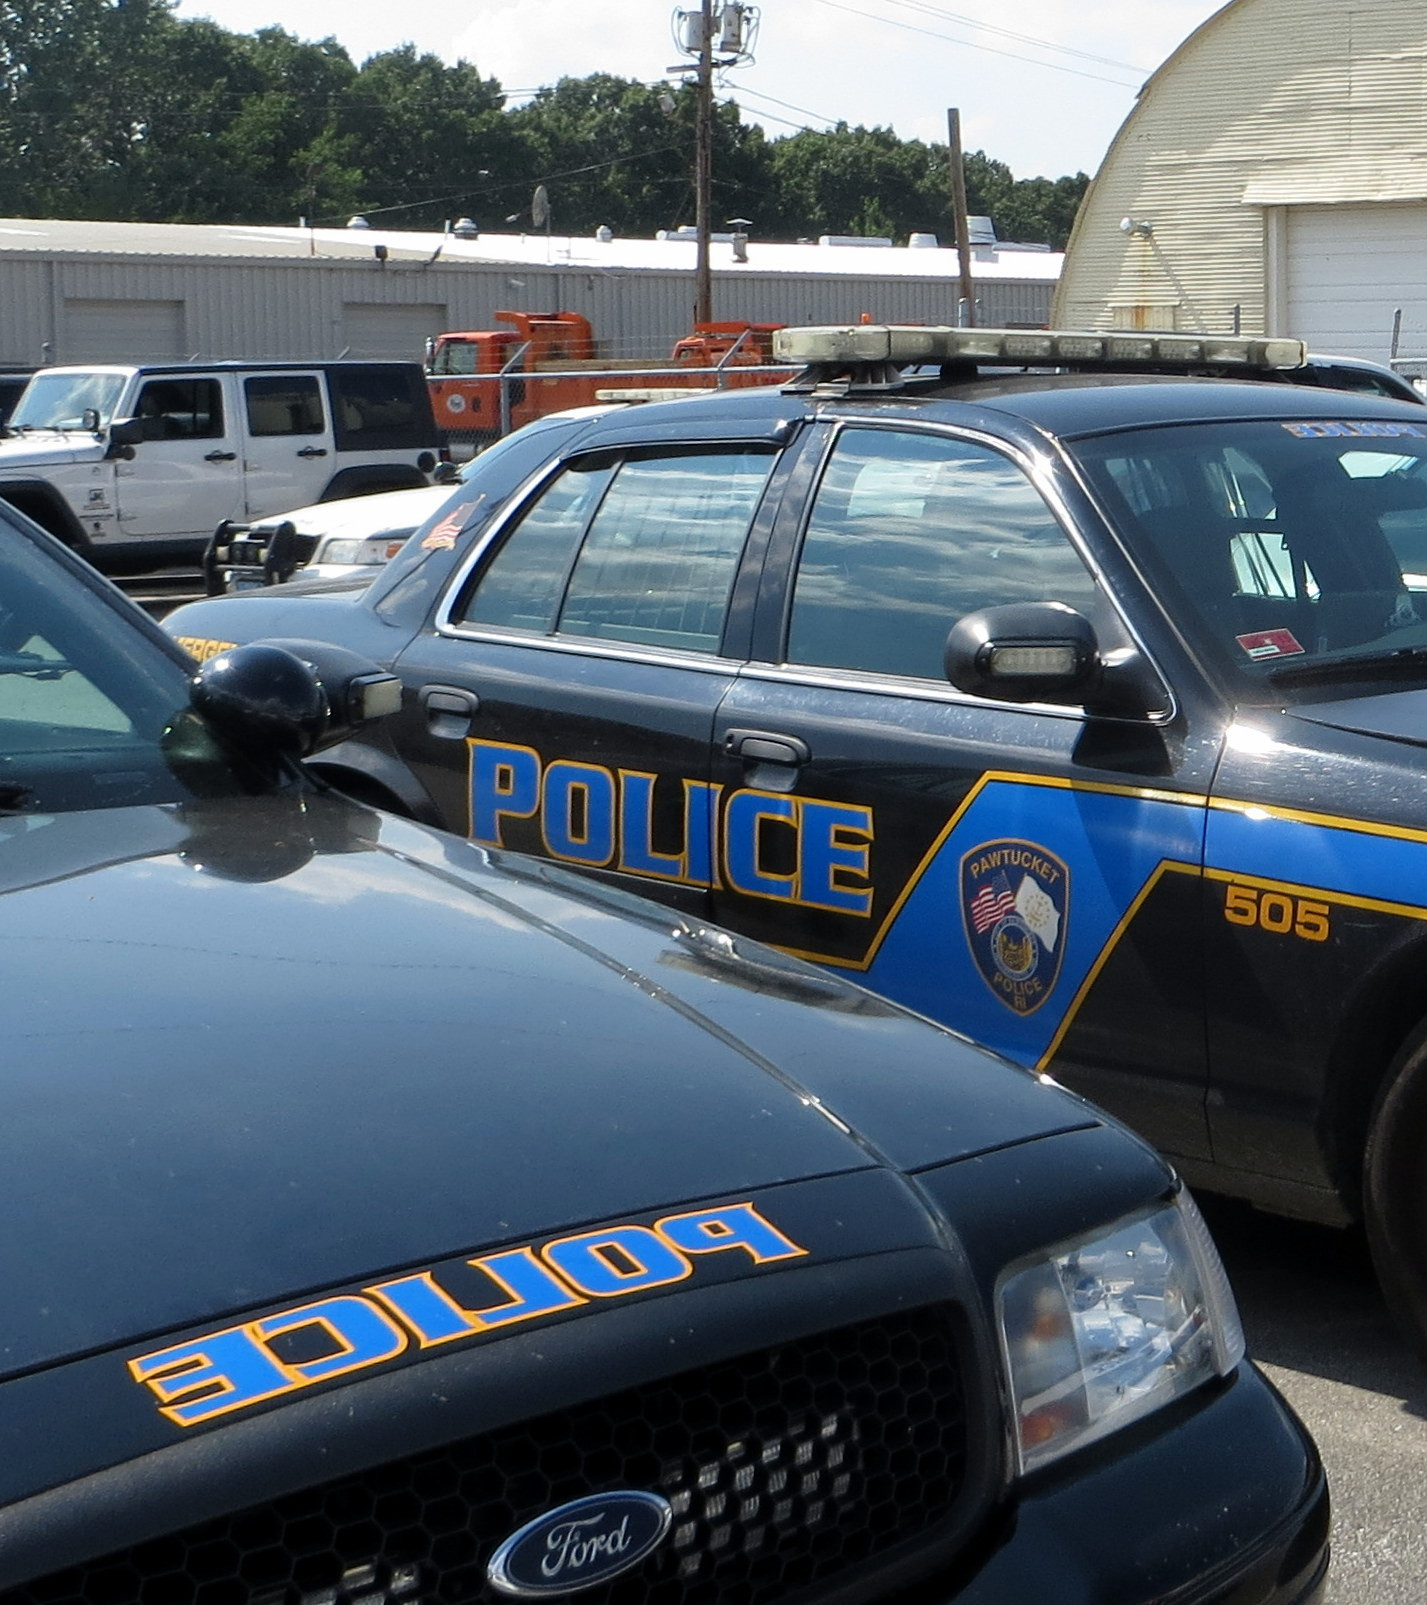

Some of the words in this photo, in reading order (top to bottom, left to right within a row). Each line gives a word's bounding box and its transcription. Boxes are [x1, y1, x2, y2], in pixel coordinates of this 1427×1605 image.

[466, 737, 875, 918] POLICE
[970, 849, 1061, 884] PAWTUCKET
[1225, 885, 1330, 942] 505
[993, 973, 1042, 995] POLICE
[541, 1511, 632, 1577] Ford
